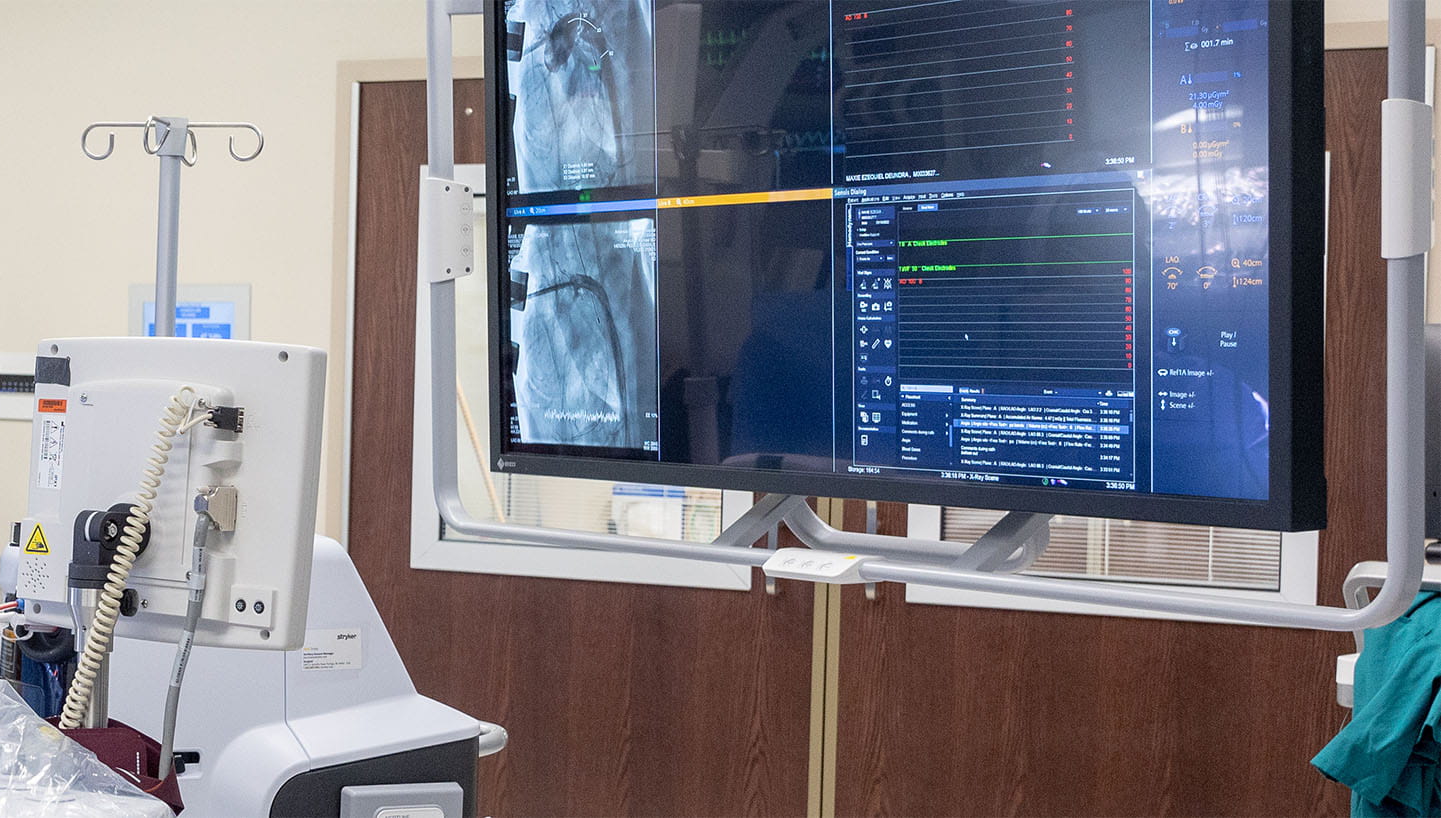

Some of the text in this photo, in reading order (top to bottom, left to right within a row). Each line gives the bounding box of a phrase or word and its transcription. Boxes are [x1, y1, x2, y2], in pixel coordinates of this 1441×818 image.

[1200, 38, 1234, 48] 001.7 min
[1188, 92, 1207, 100] 21.30
[1192, 101, 1207, 109] 4.00
[850, 188, 867, 197] Dialog
[1165, 256, 1180, 264] LAO
[1243, 258, 1263, 267] 40cm
[1221, 331, 1232, 340] Play
[1220, 340, 1237, 348] Pause
[1187, 369, 1205, 378] Image
[1170, 391, 1187, 399] Image
[1170, 401, 1187, 409] Scene
